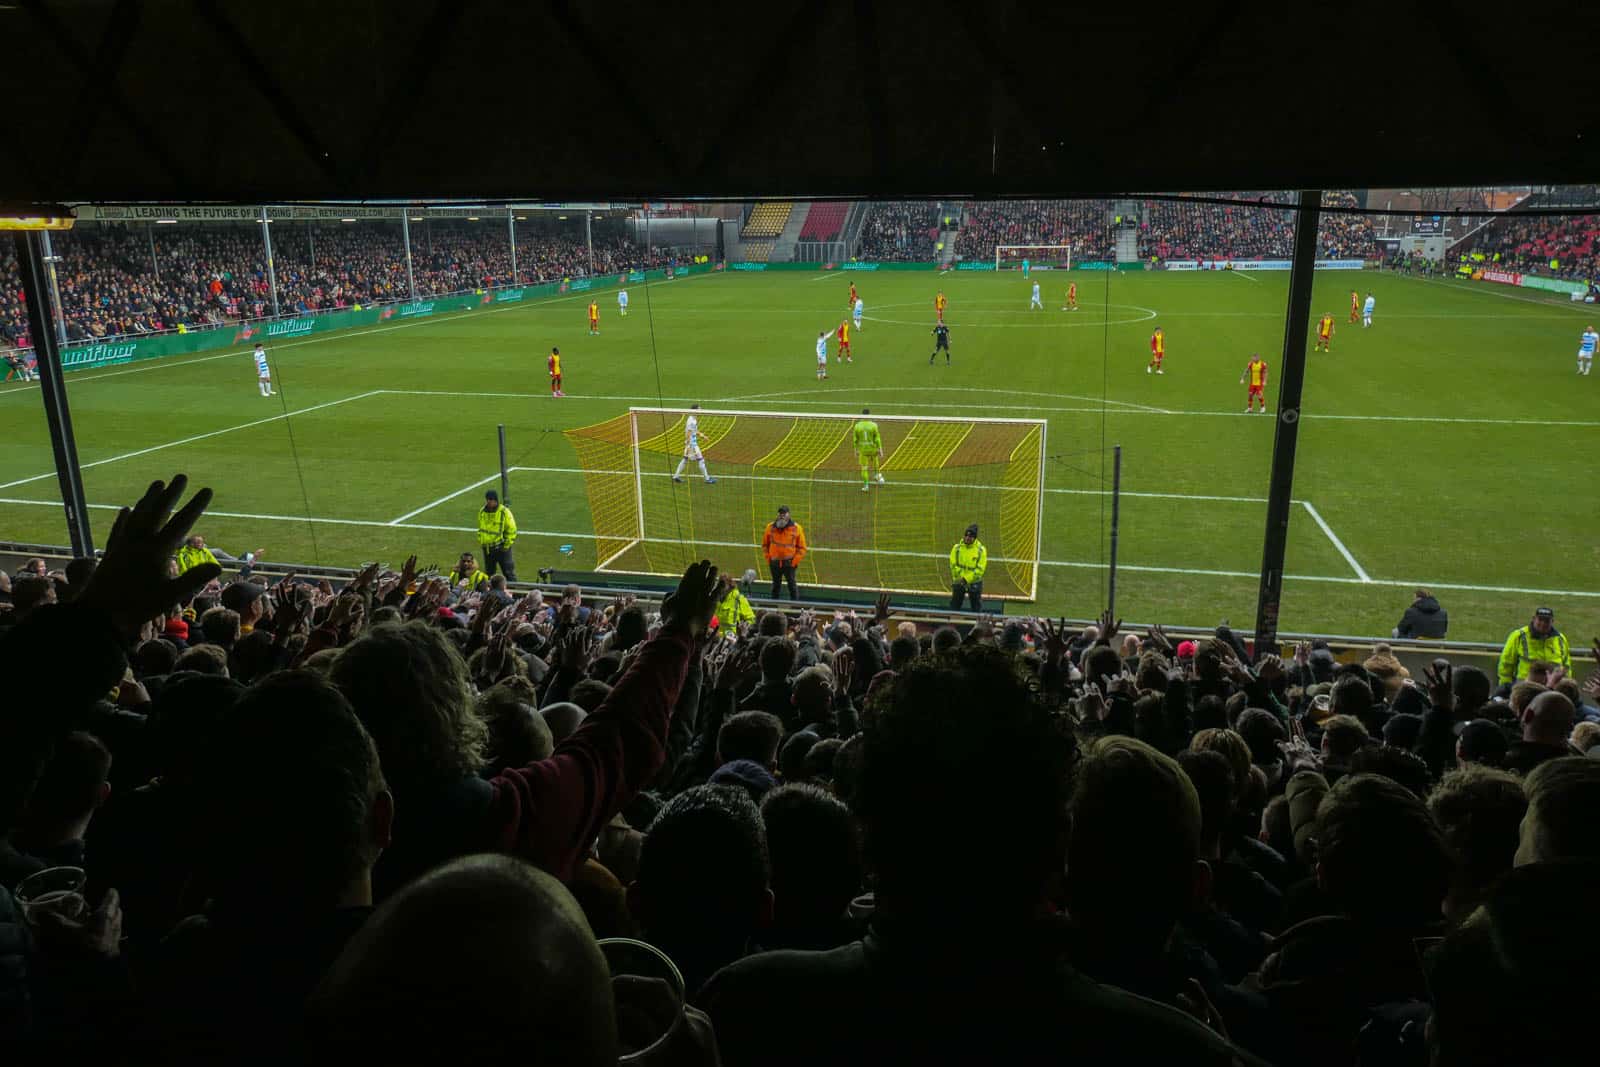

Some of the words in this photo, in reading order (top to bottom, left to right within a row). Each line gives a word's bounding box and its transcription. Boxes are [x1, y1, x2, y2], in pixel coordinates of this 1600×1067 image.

[135, 207, 180, 218] LEADING
[182, 207, 201, 218] THE
[203, 207, 239, 218] FUTURE
[240, 207, 250, 218] OF
[253, 207, 292, 218] BRDGING
